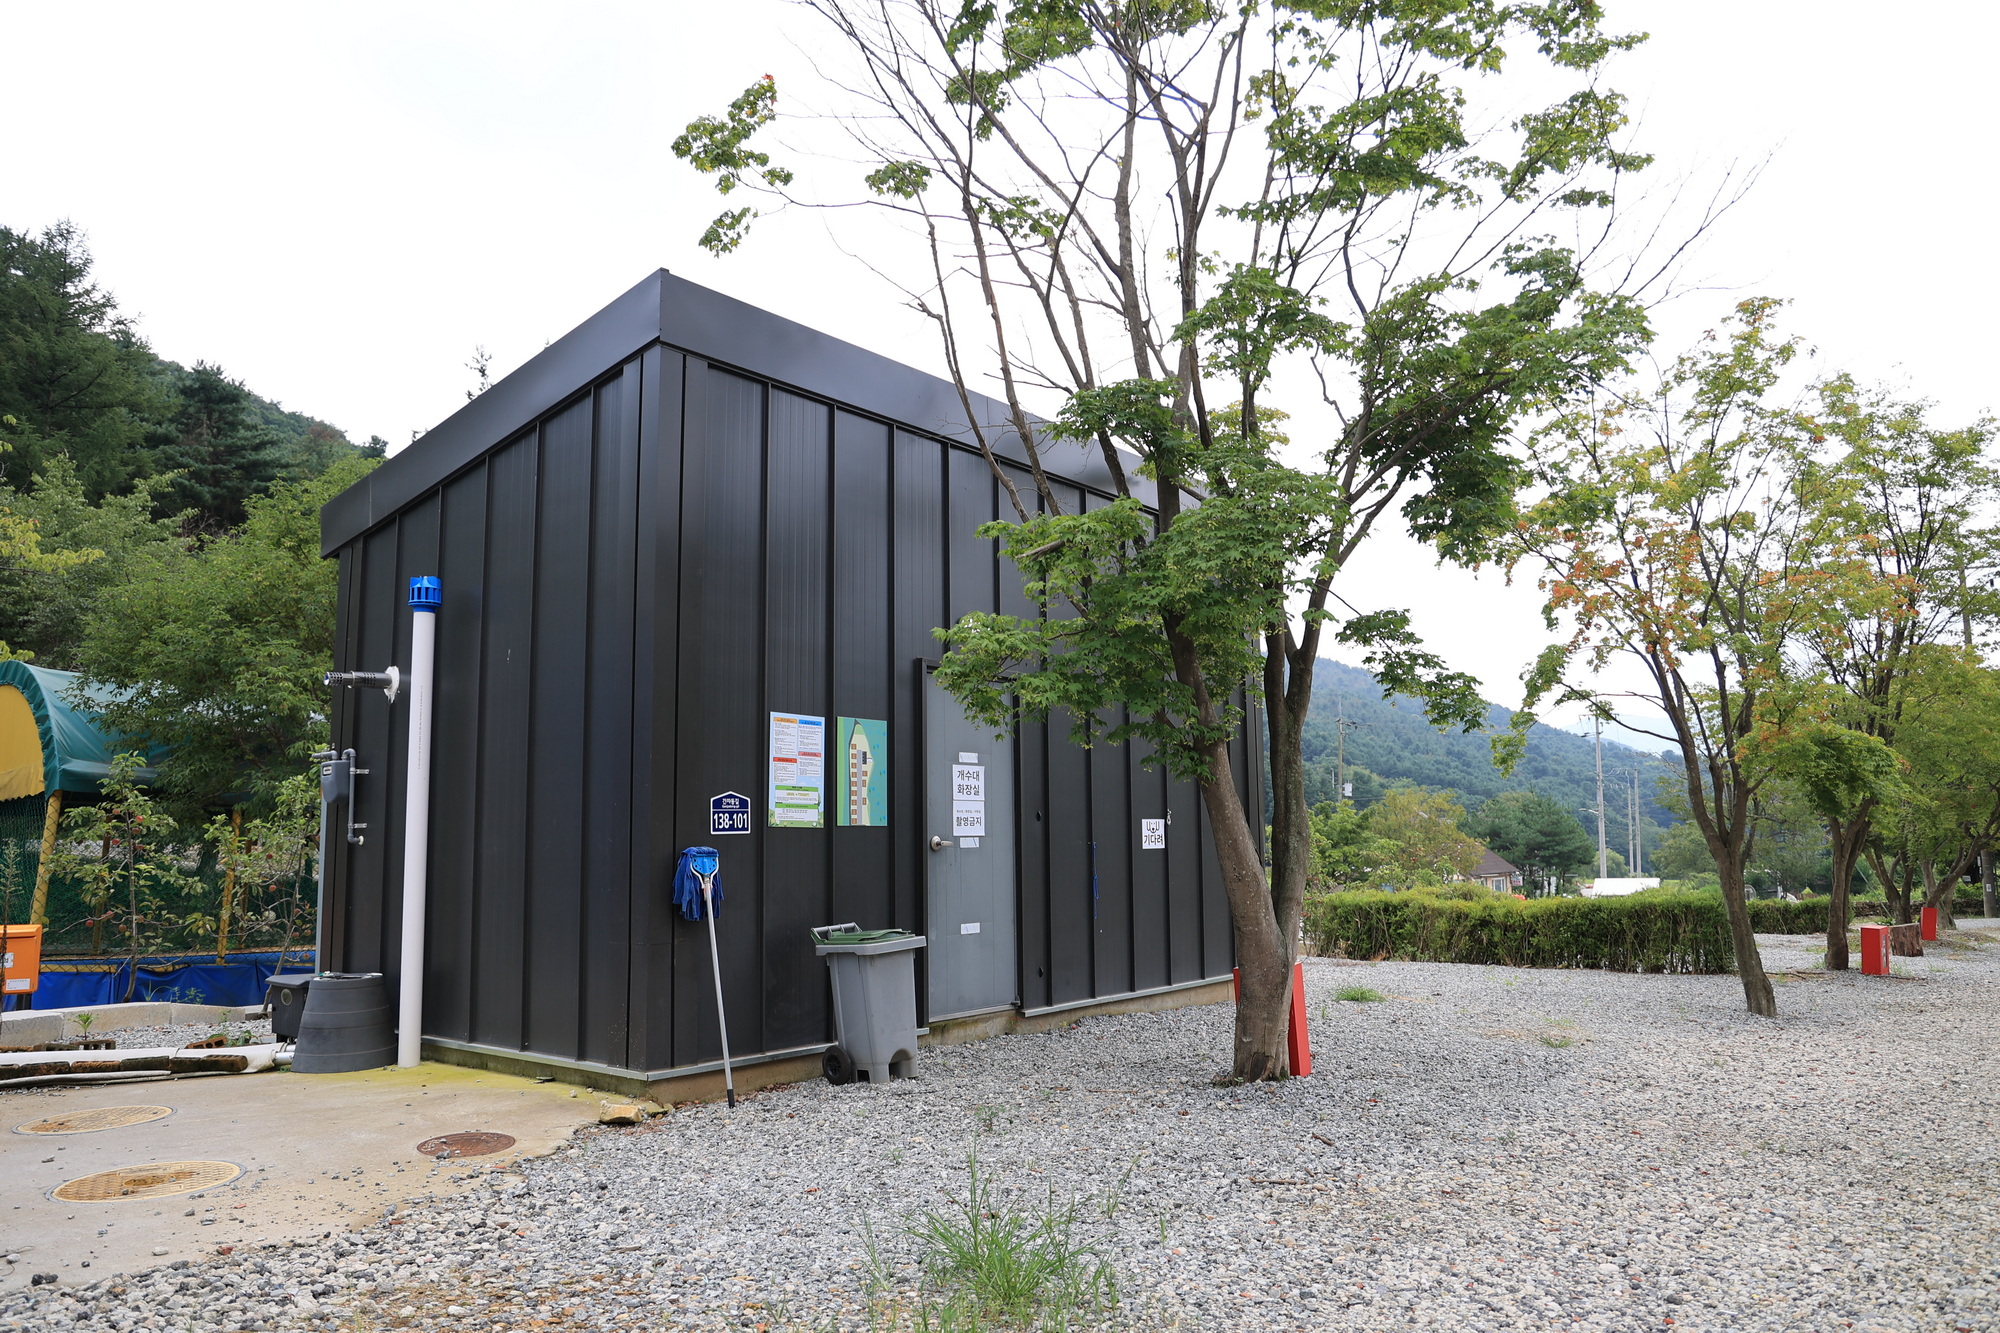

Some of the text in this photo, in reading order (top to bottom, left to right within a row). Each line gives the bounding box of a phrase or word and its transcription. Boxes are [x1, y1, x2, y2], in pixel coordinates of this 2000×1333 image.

[957, 770, 980, 782] 개수대
[957, 783, 980, 796] 화장실
[714, 813, 747, 828] 138-101
[956, 816, 982, 827] 촬영금지
[1144, 834, 1163, 845] 기다려
